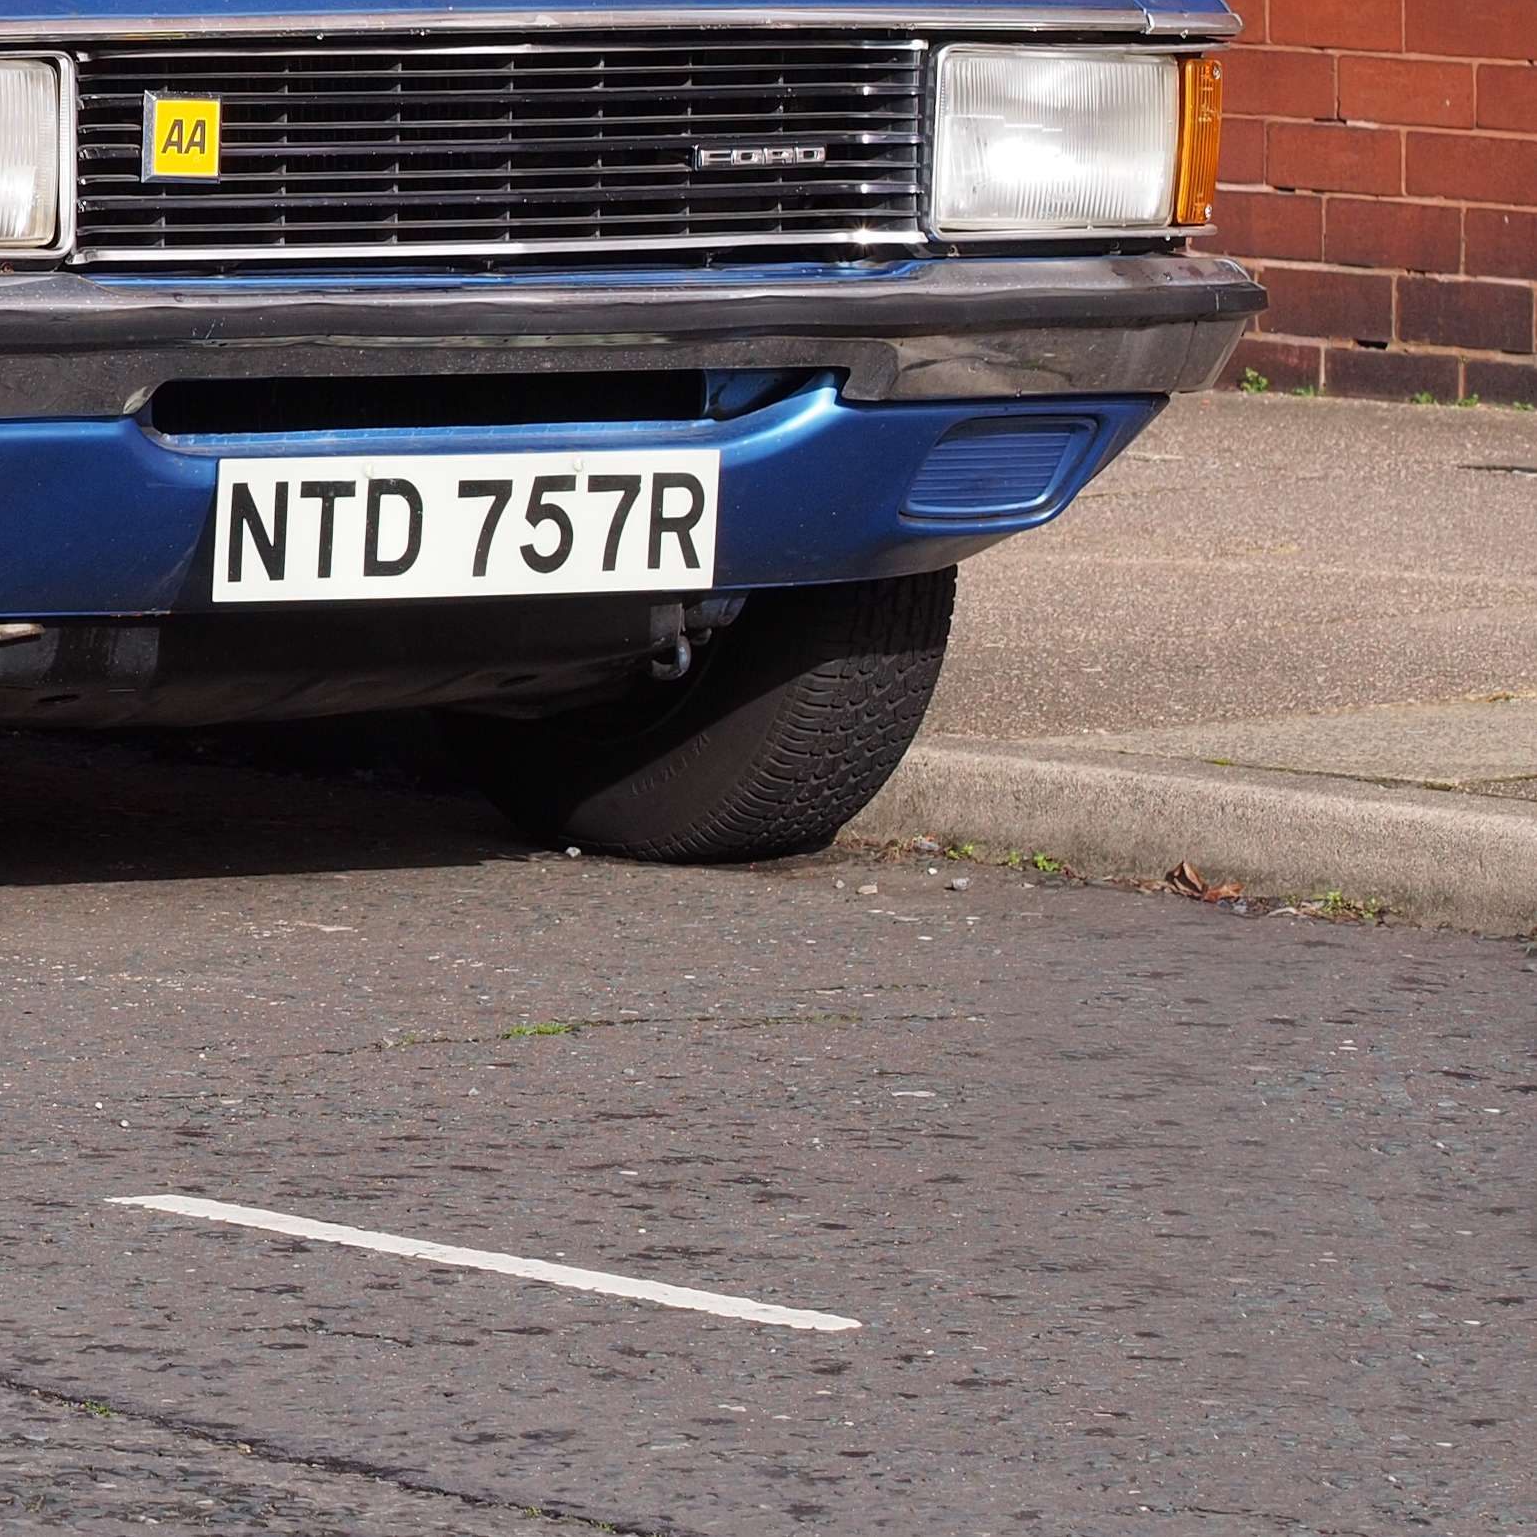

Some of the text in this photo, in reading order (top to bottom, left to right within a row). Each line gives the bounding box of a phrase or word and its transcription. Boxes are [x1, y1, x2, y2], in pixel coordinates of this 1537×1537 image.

[160, 119, 207, 155] AA
[696, 145, 825, 167] FORD
[227, 472, 706, 583] NTD 757R
